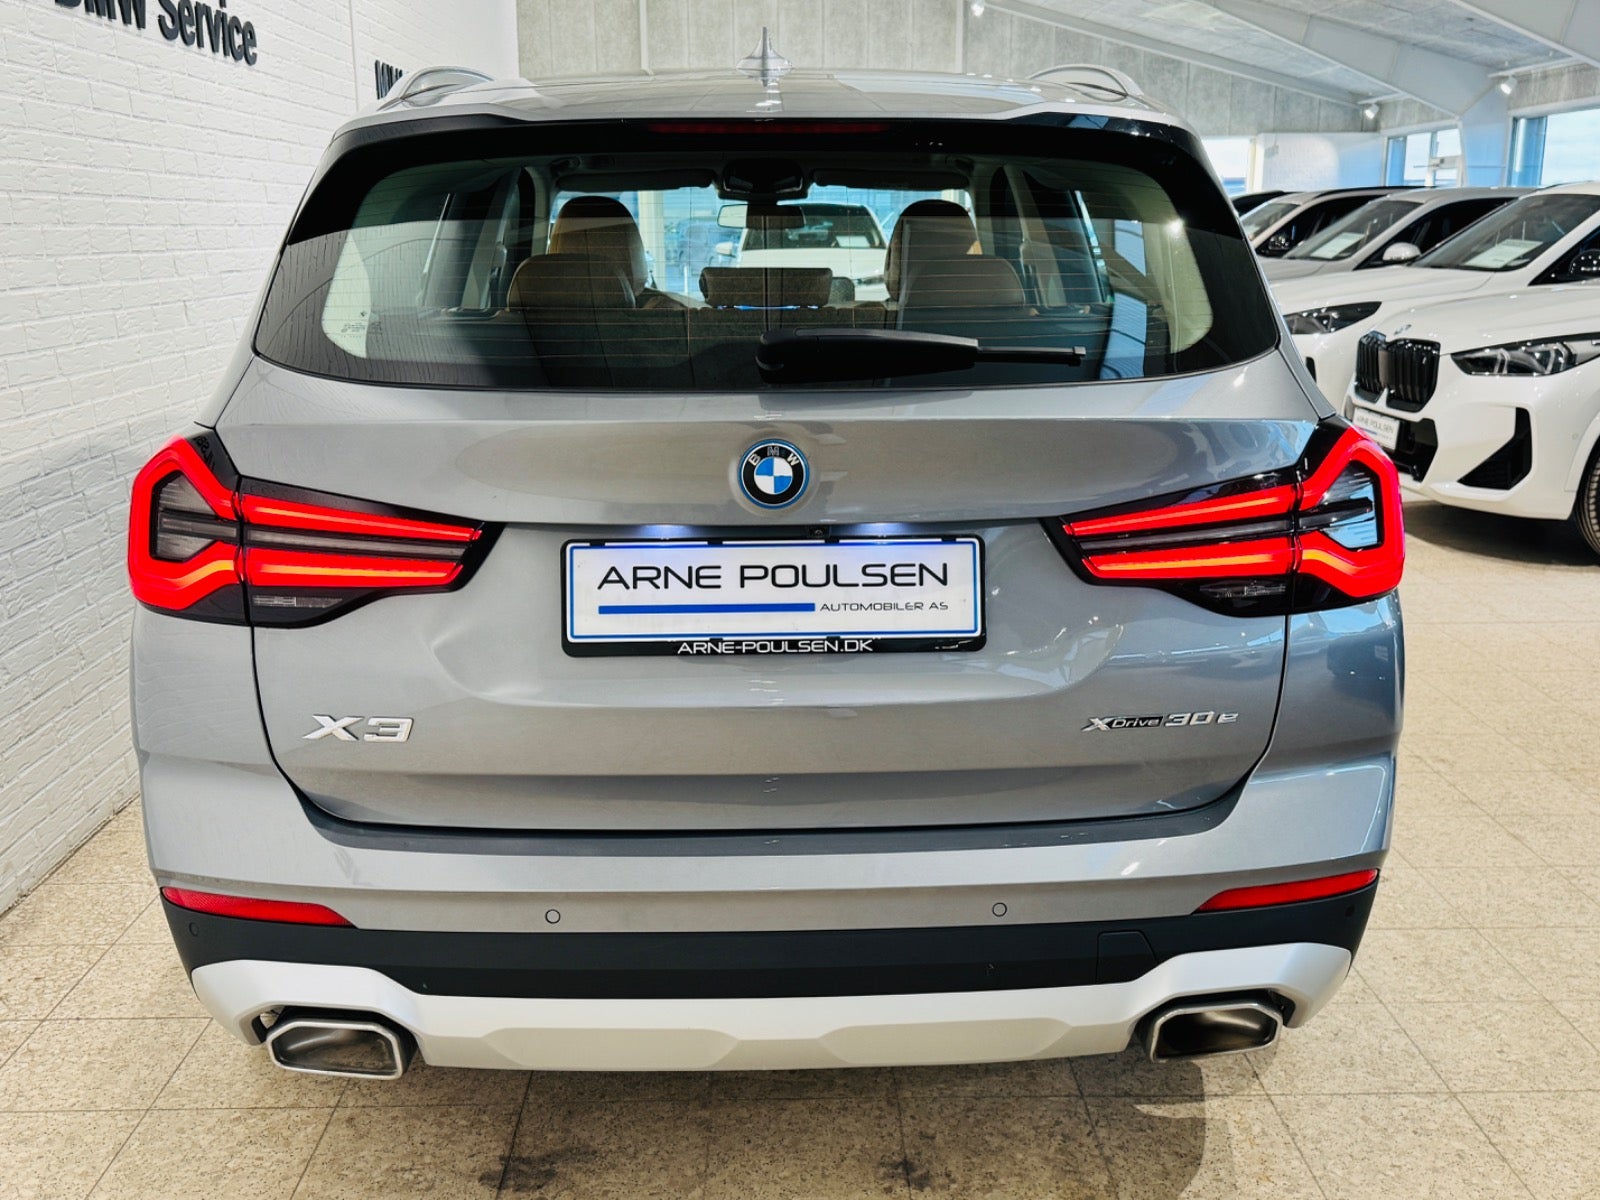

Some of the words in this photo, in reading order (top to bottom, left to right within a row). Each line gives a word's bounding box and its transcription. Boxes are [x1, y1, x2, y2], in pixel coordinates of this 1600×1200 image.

[158, 0, 257, 66] Service
[748, 446, 799, 466] BMW
[597, 565, 722, 590] ARNE
[740, 563, 948, 588] POULSEN
[819, 601, 924, 612] AUTOMOBILER
[929, 601, 949, 611] AS
[677, 639, 874, 655] ARNE-POULSEN.DK
[302, 714, 414, 743] X3
